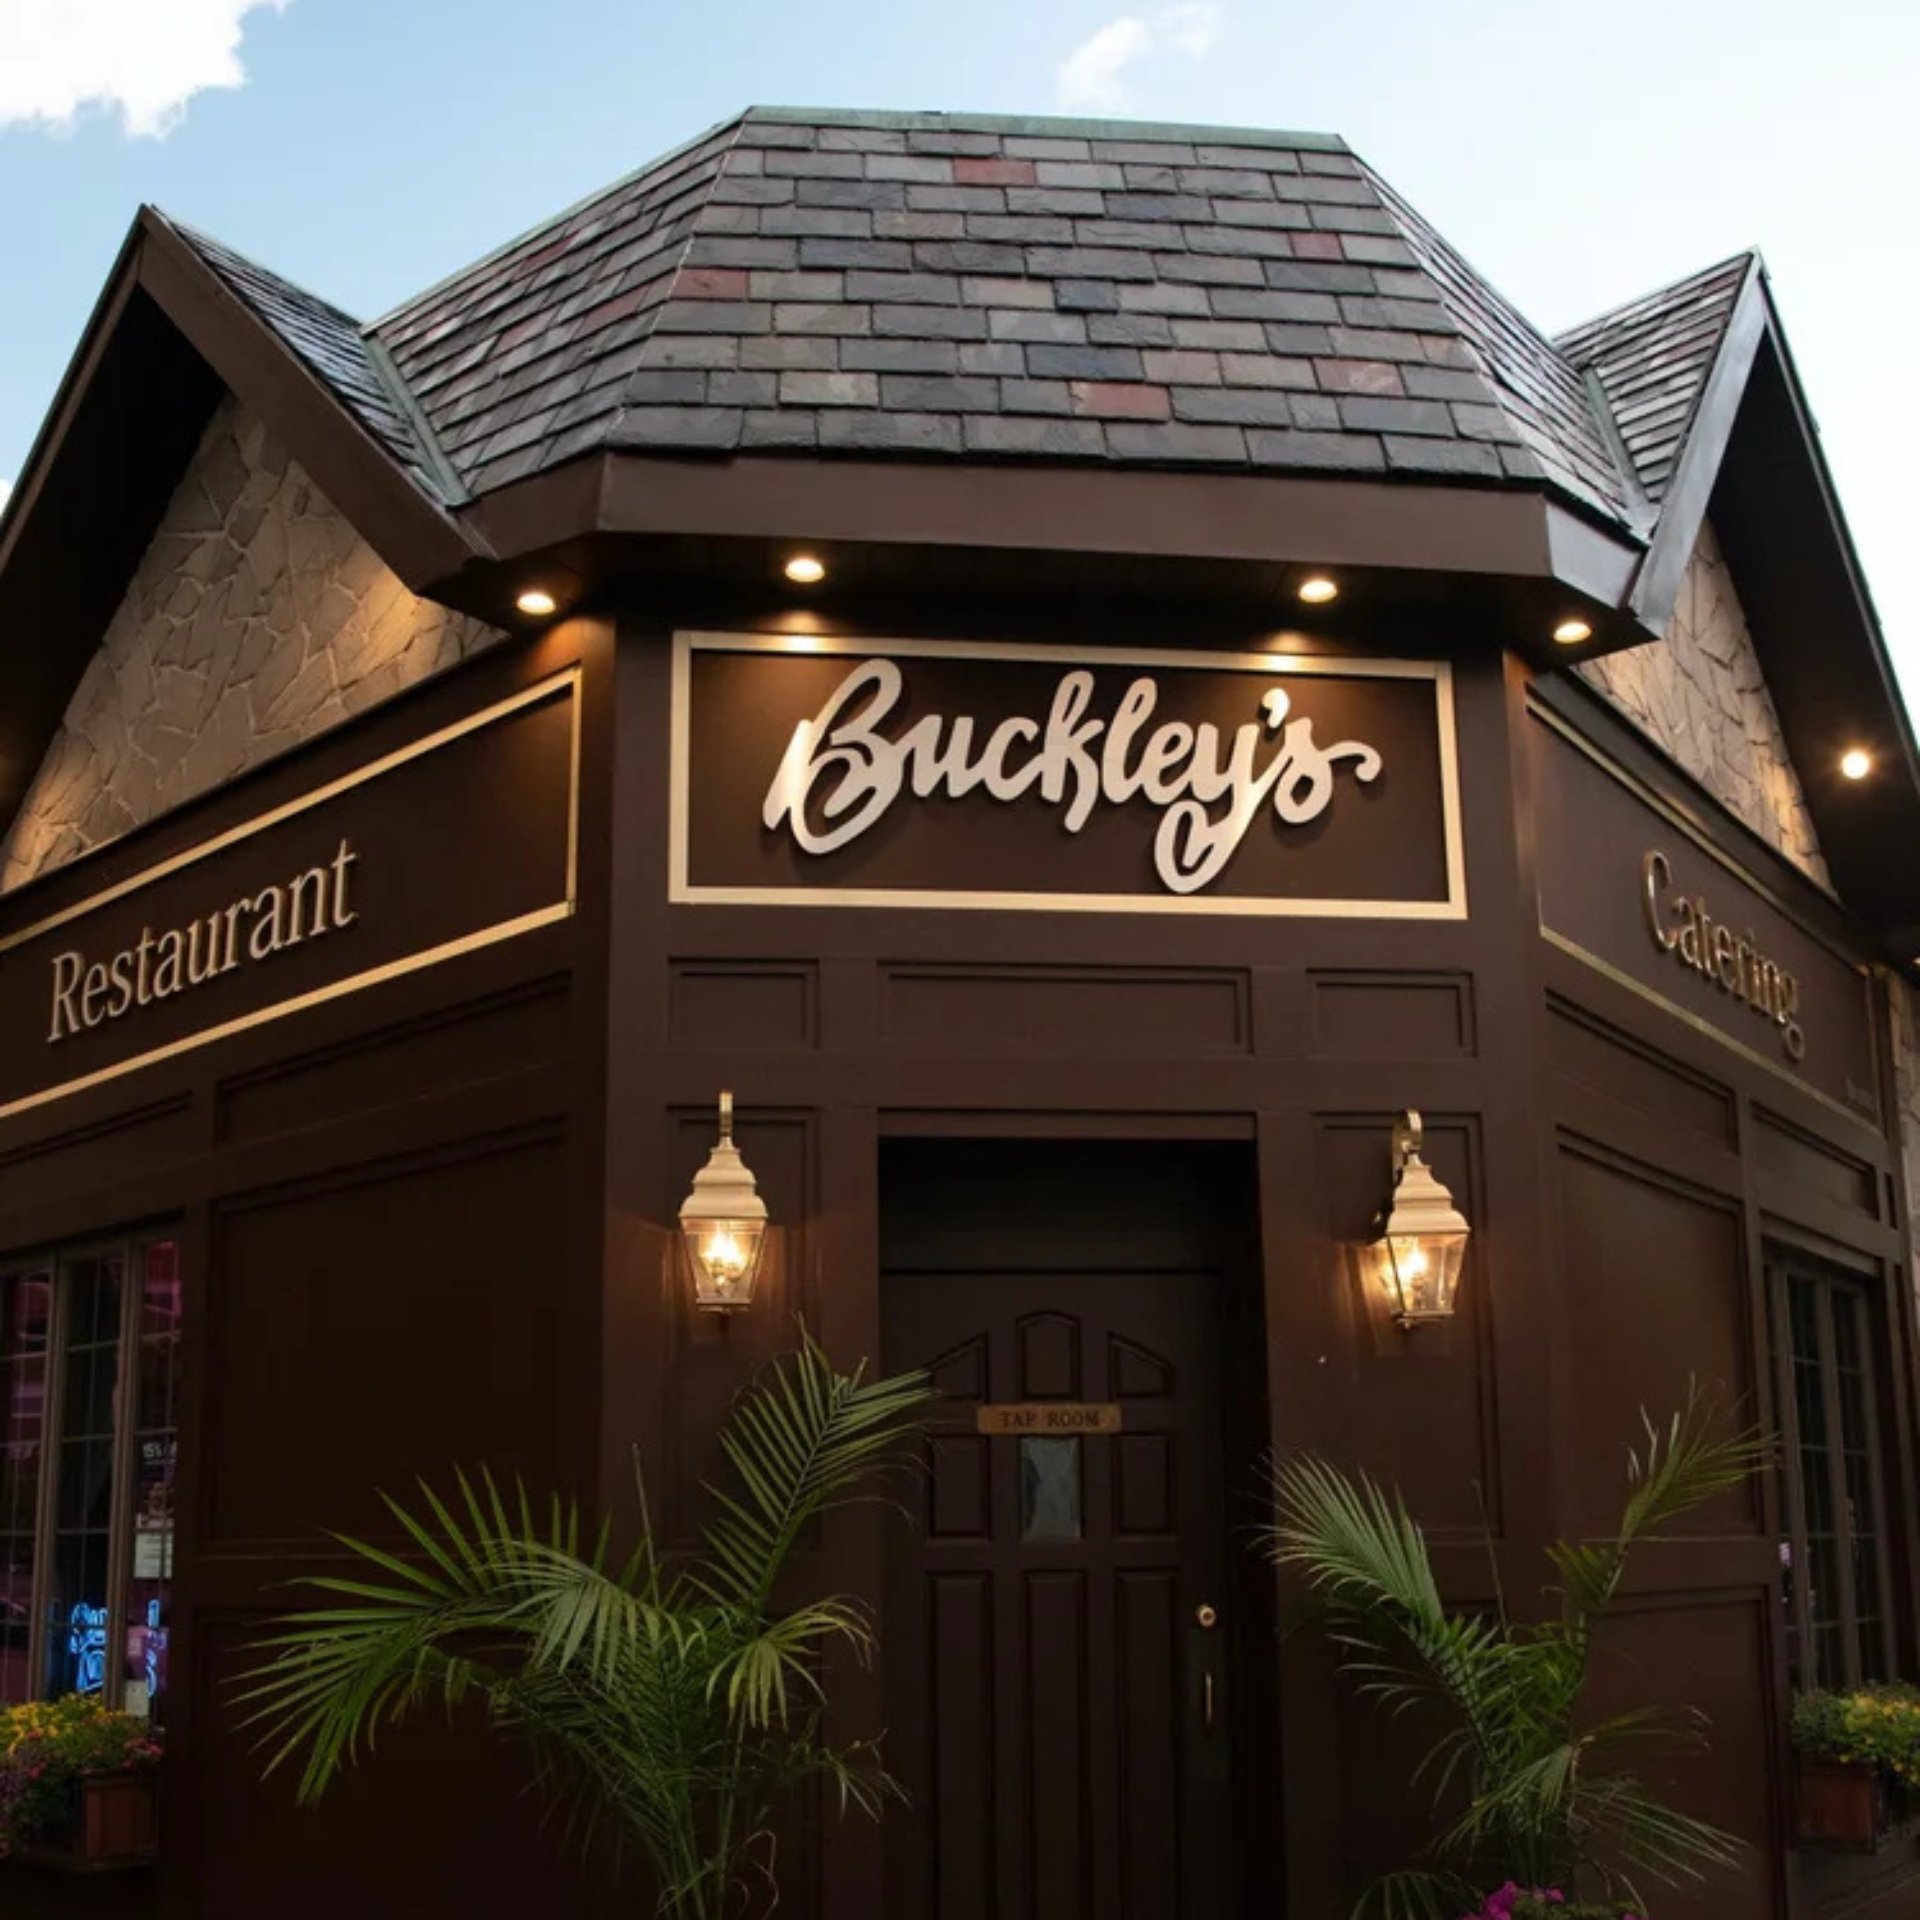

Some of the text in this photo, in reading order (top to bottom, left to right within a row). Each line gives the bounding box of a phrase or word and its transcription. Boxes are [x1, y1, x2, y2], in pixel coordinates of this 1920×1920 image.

[761, 658, 1383, 894] Buckley's
[46, 838, 358, 1043] Restaurant
[1644, 849, 1806, 1062] Catering
[999, 1410, 1101, 1428] TAP ROOM
